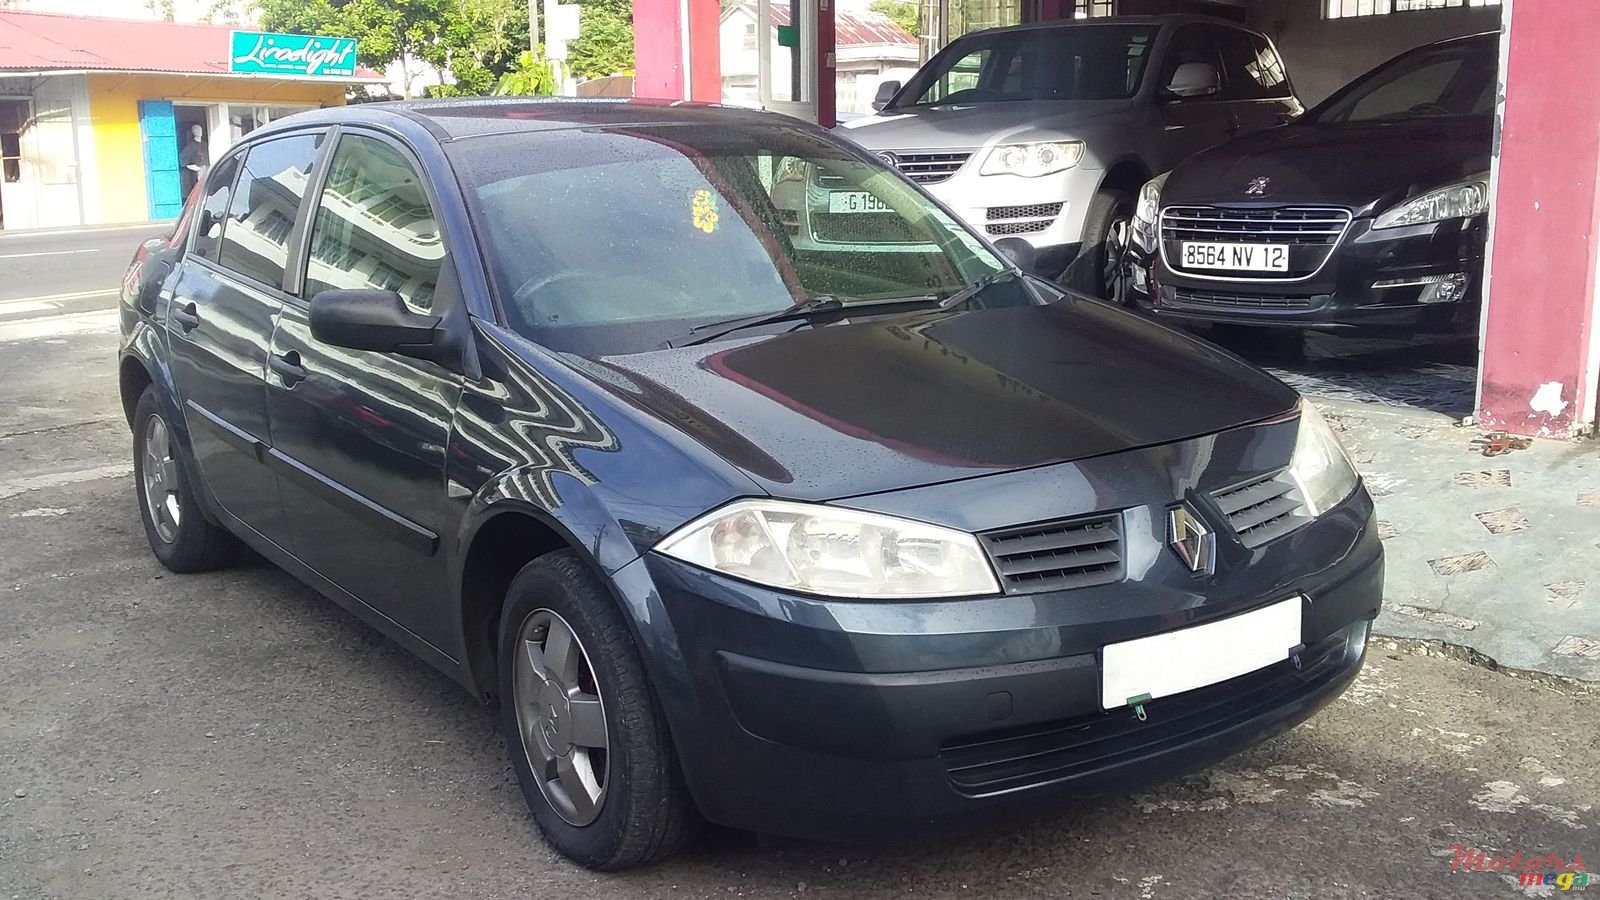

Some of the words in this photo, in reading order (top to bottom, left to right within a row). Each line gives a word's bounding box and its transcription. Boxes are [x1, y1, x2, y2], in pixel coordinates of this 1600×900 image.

[1186, 245, 1226, 266] 8564
[1232, 246, 1254, 267] NV
[1263, 247, 1284, 268] 12
